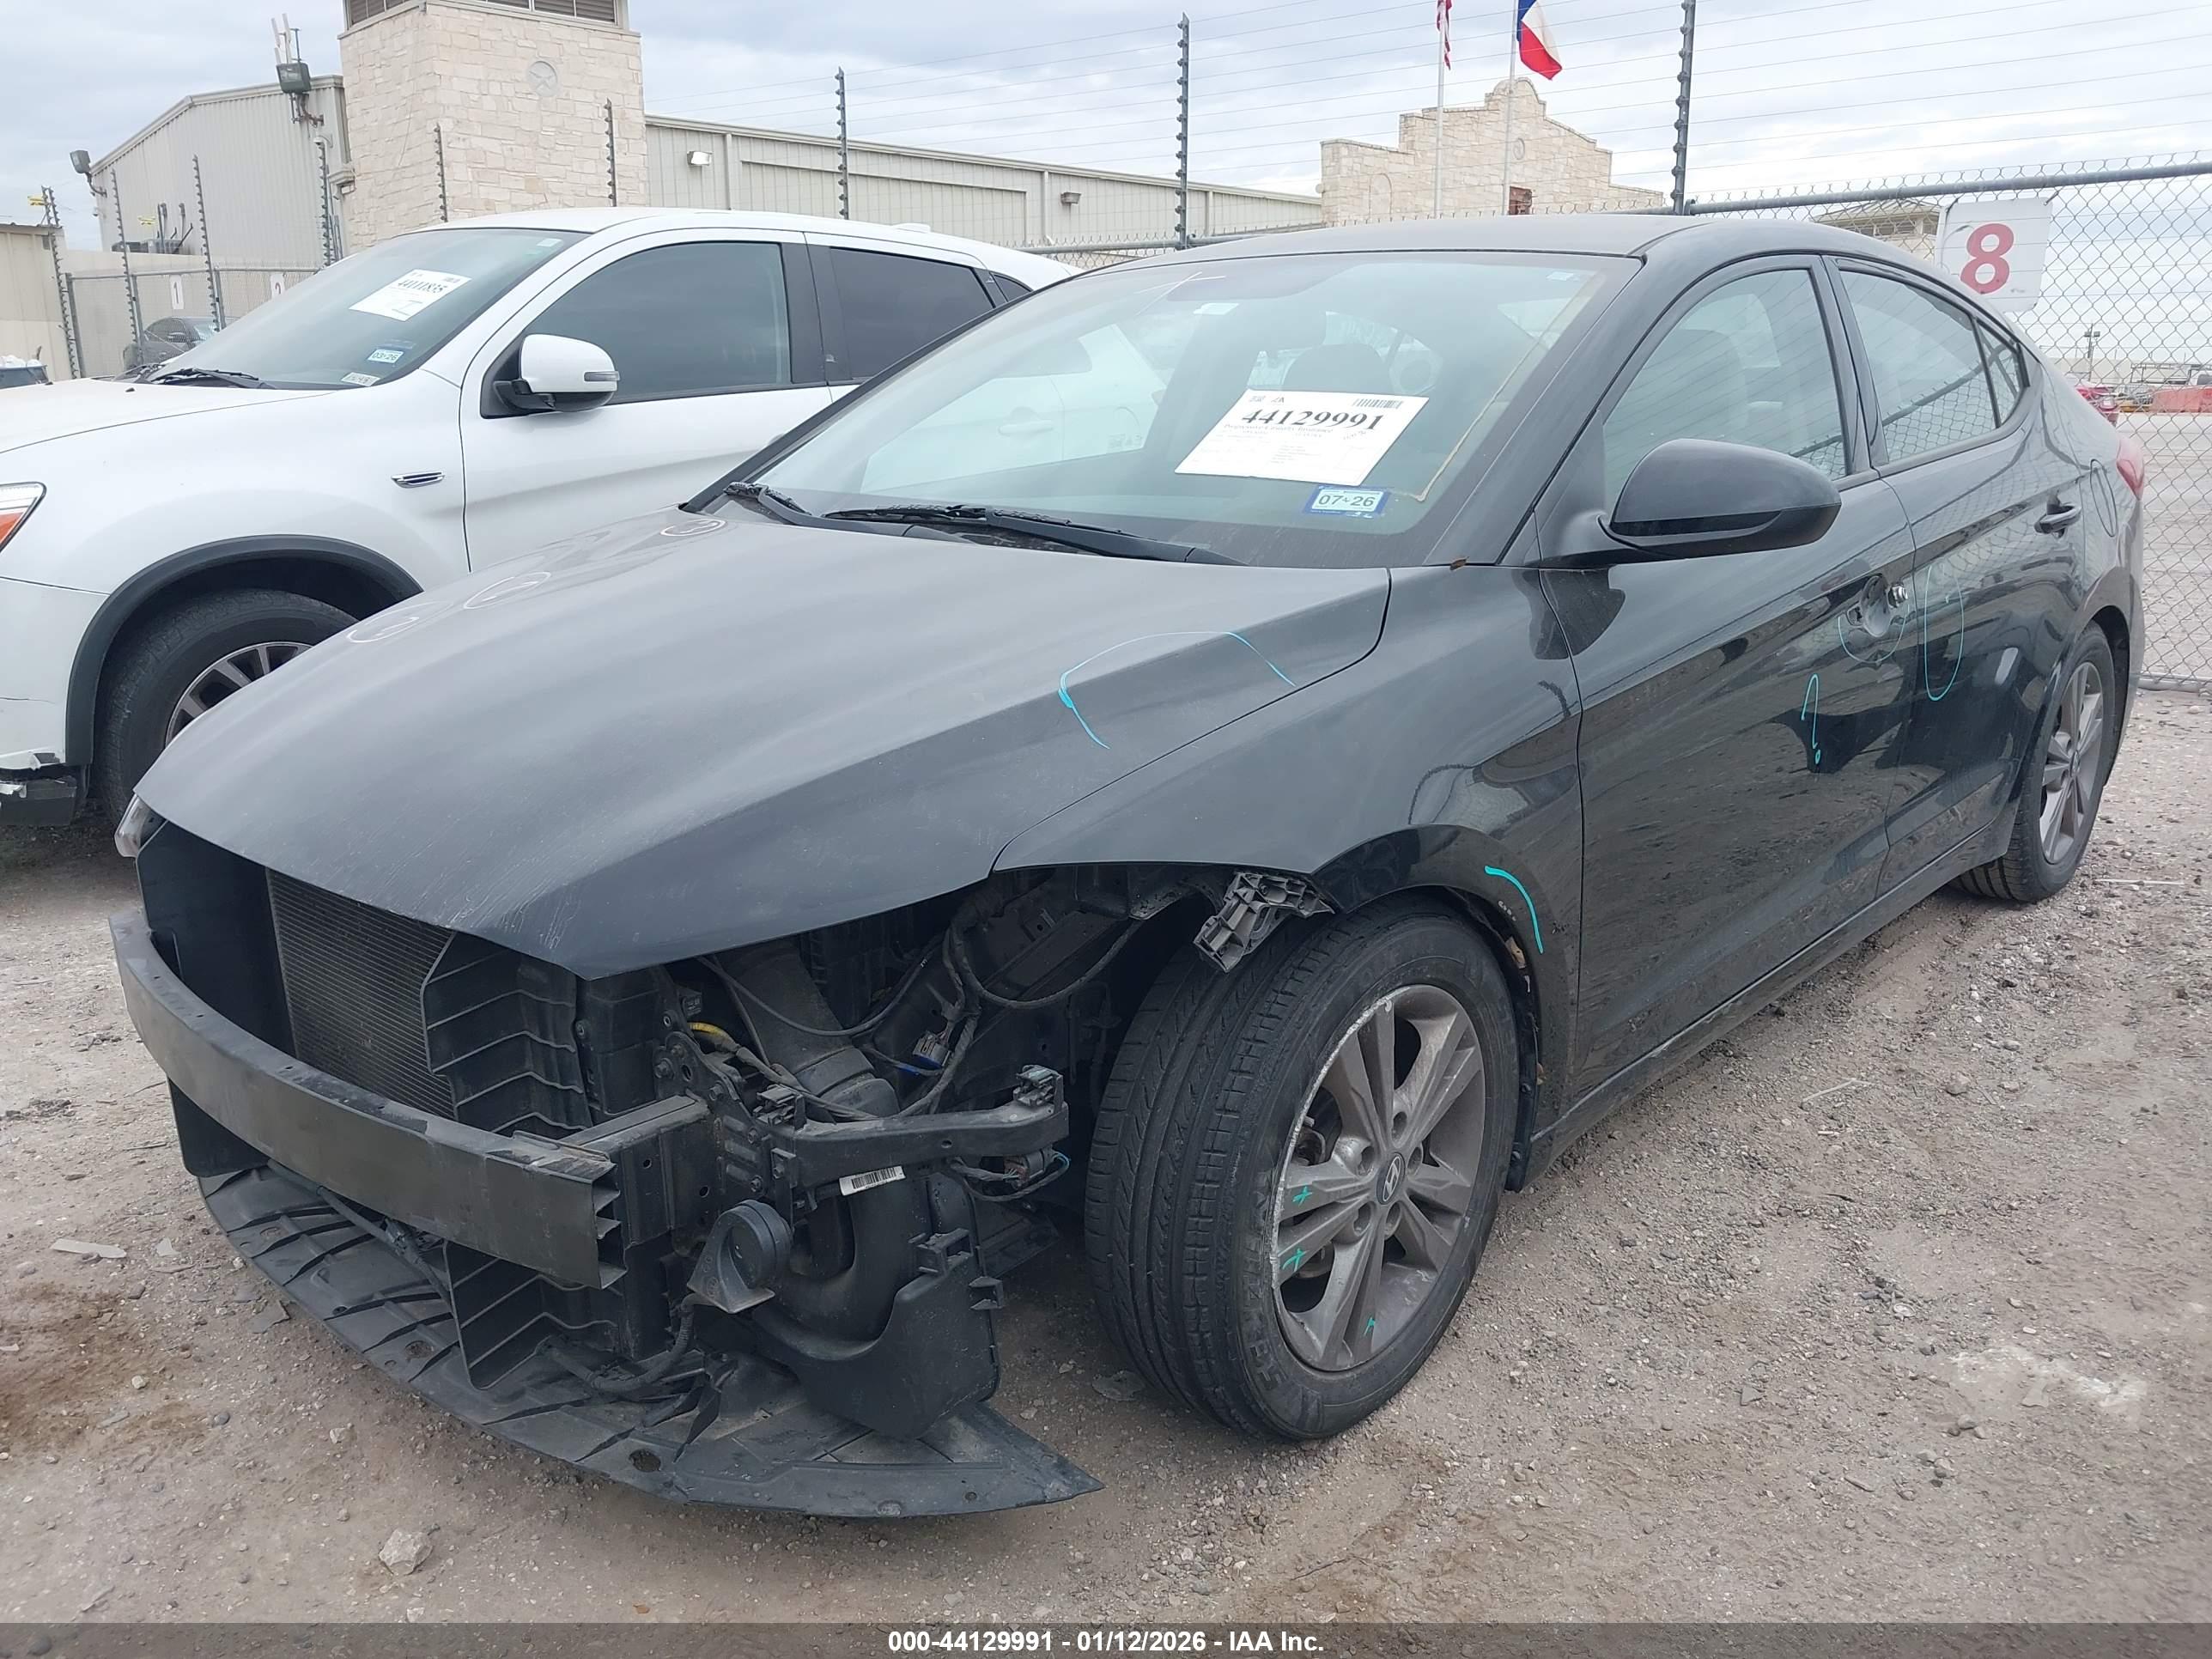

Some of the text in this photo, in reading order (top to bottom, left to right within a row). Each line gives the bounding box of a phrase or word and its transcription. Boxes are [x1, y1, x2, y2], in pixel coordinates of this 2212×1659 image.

[1960, 222, 2014, 295] 8
[173, 282, 179, 304] 1
[1242, 409, 1384, 430] 44129991
[1318, 495, 1376, 507] 07 26
